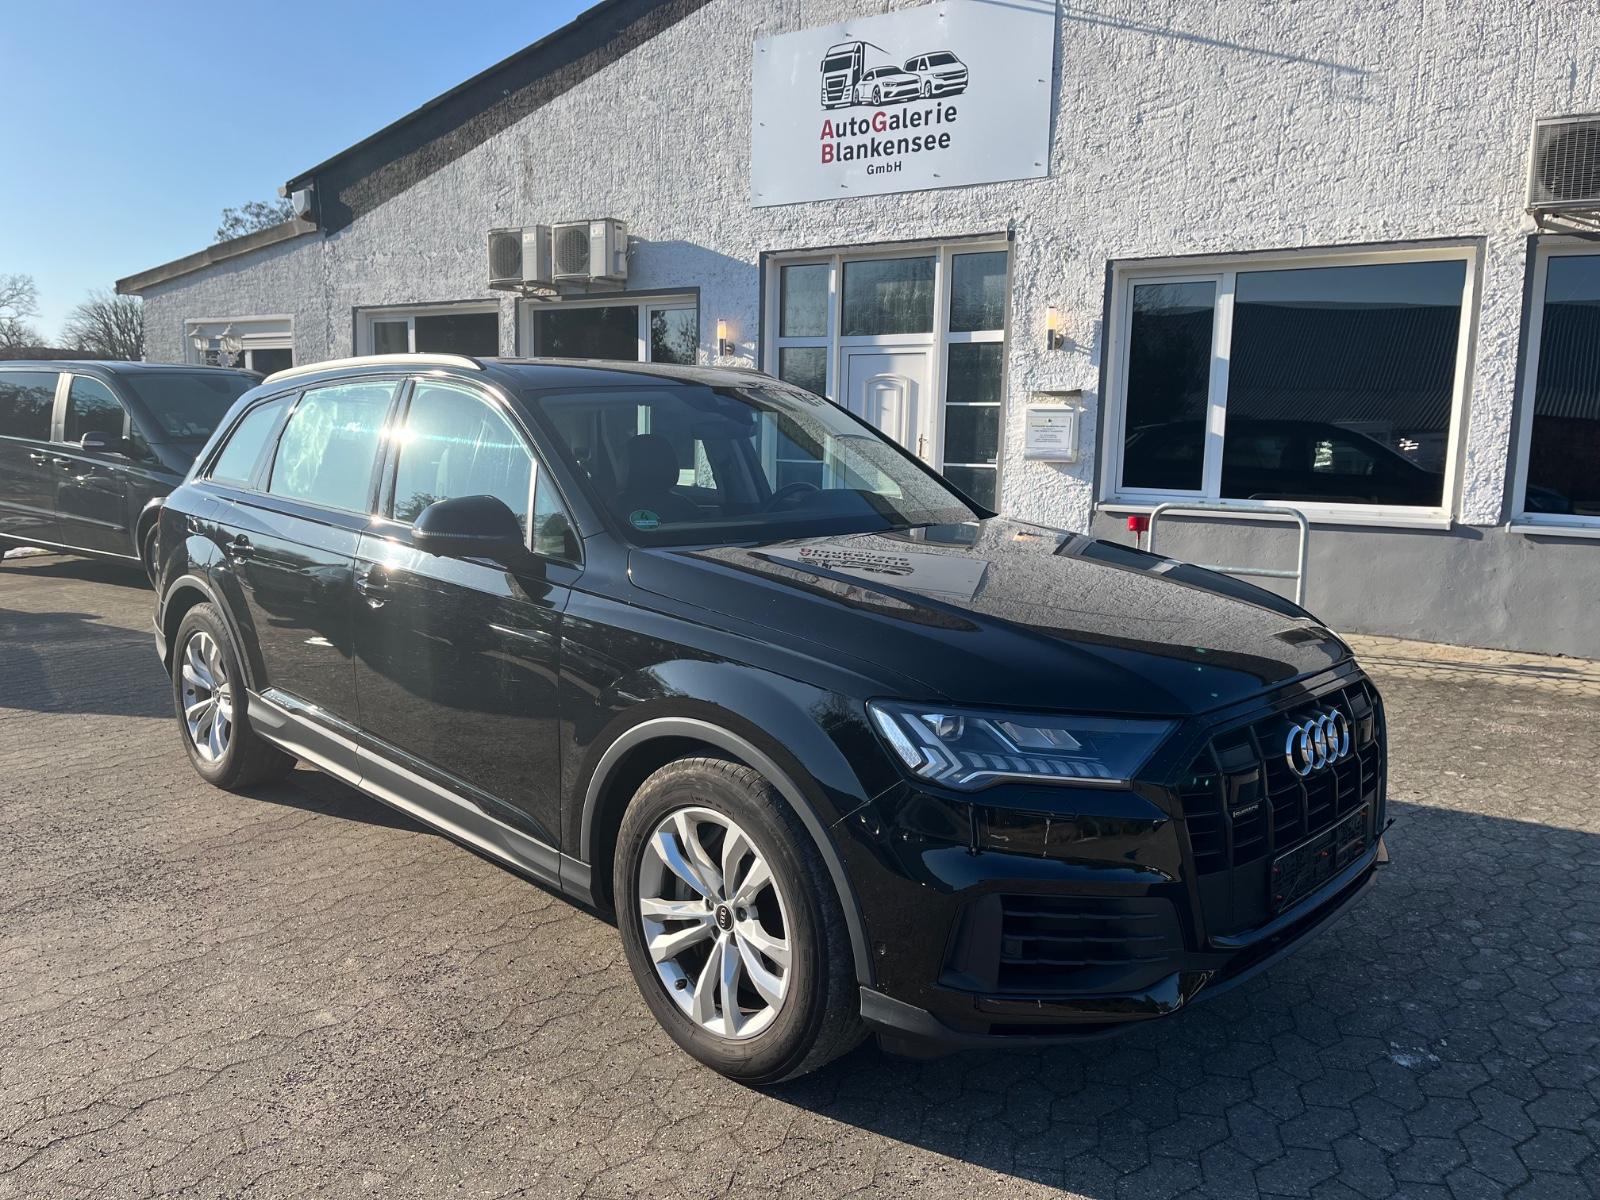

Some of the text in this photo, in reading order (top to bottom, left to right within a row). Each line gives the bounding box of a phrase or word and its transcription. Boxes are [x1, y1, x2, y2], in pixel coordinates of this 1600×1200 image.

[820, 102, 957, 140] AutoGalerie
[821, 132, 951, 164] Blankensee
[866, 161, 902, 175] GmbH
